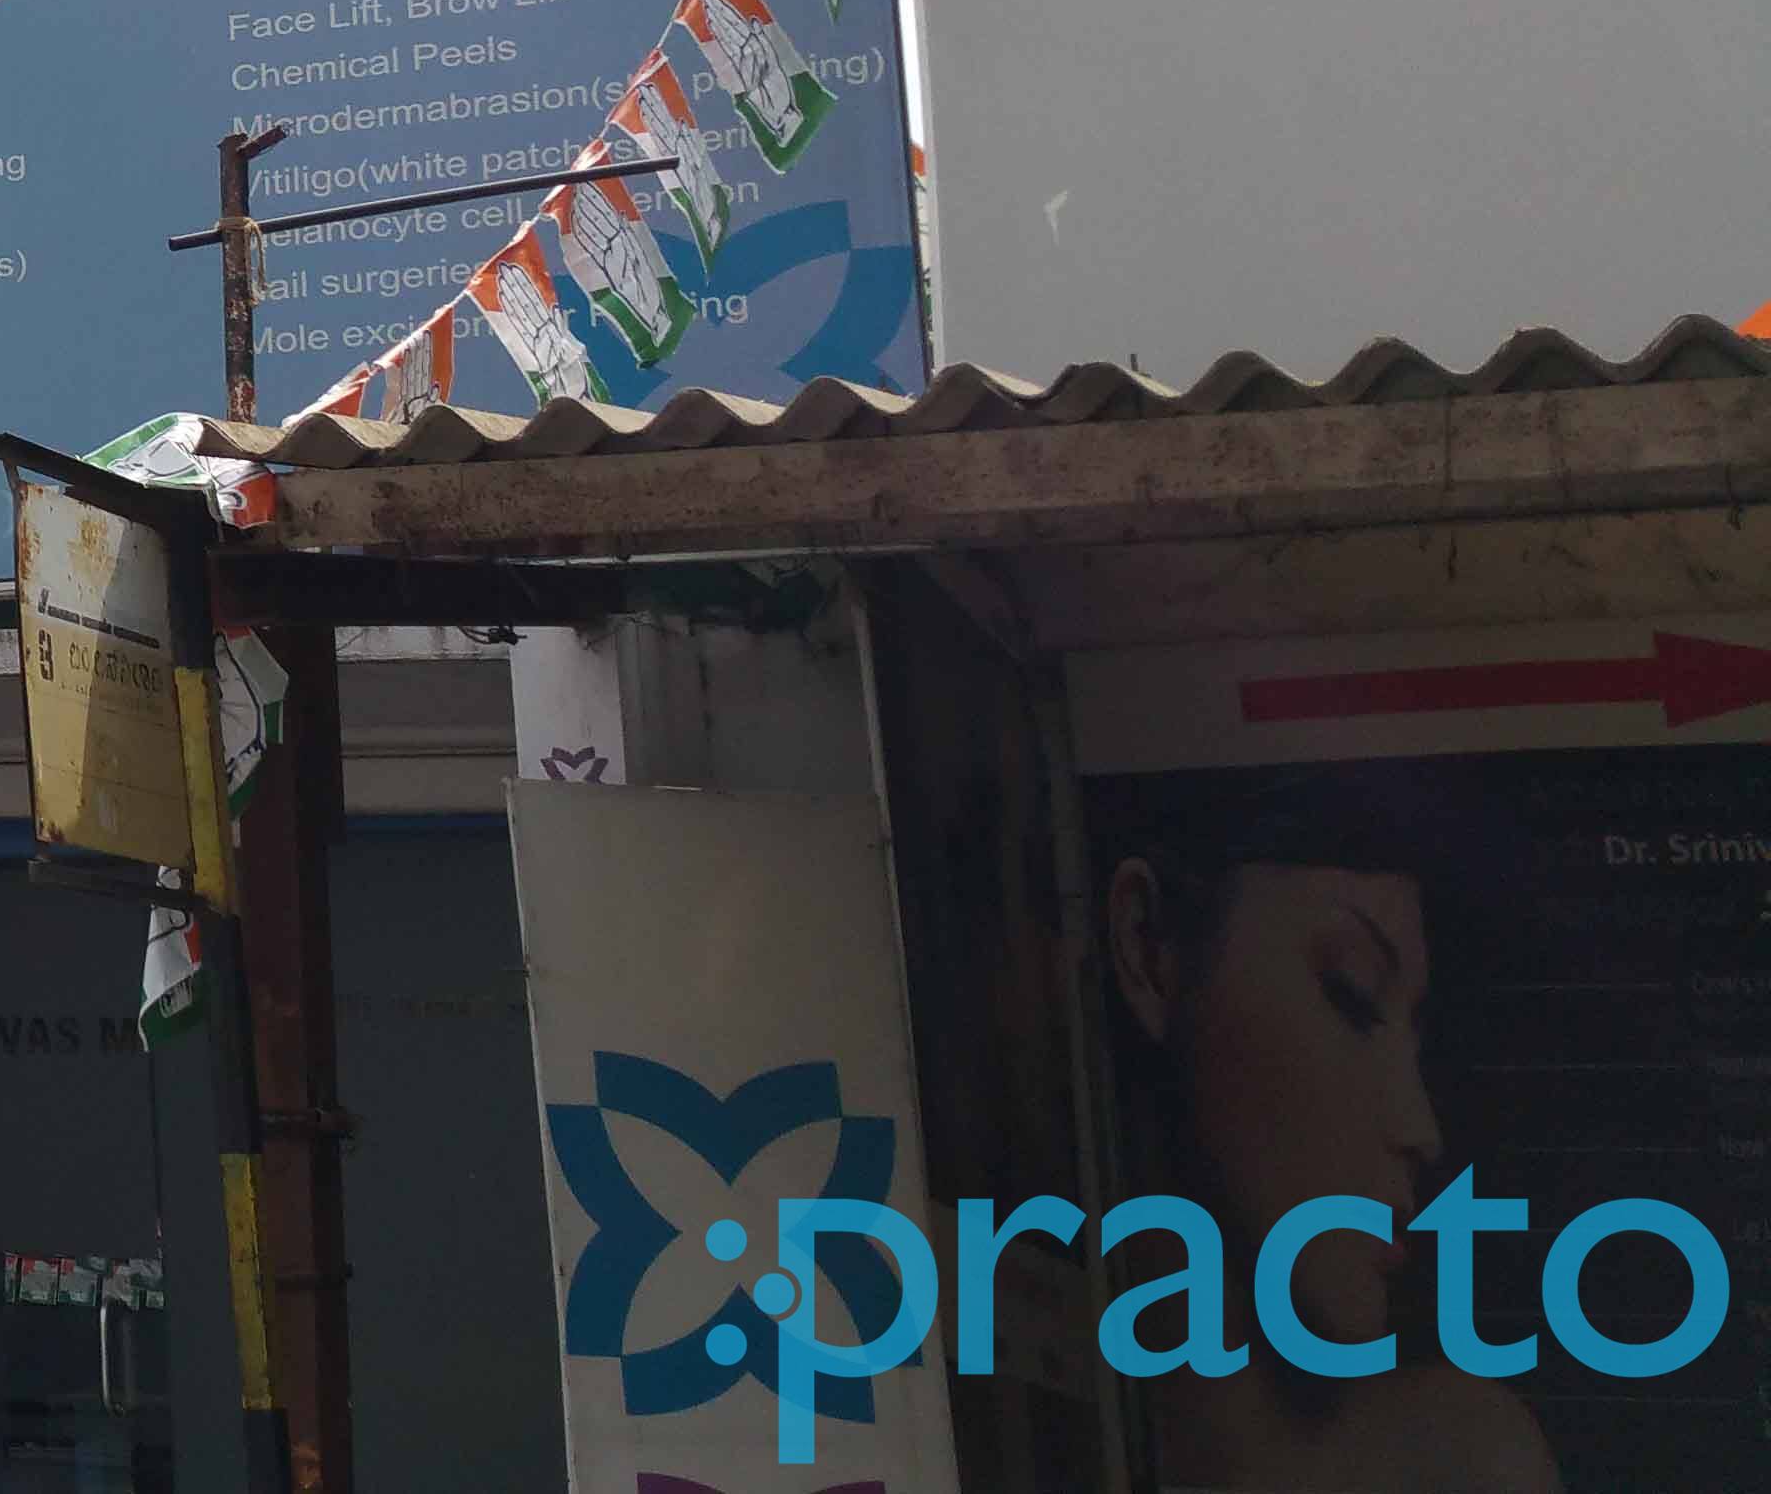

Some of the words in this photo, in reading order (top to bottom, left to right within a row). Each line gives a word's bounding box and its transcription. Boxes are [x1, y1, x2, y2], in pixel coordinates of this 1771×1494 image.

[229, 13, 315, 40] Face
[232, 47, 398, 90] Chemical
[414, 36, 517, 70] Peels
